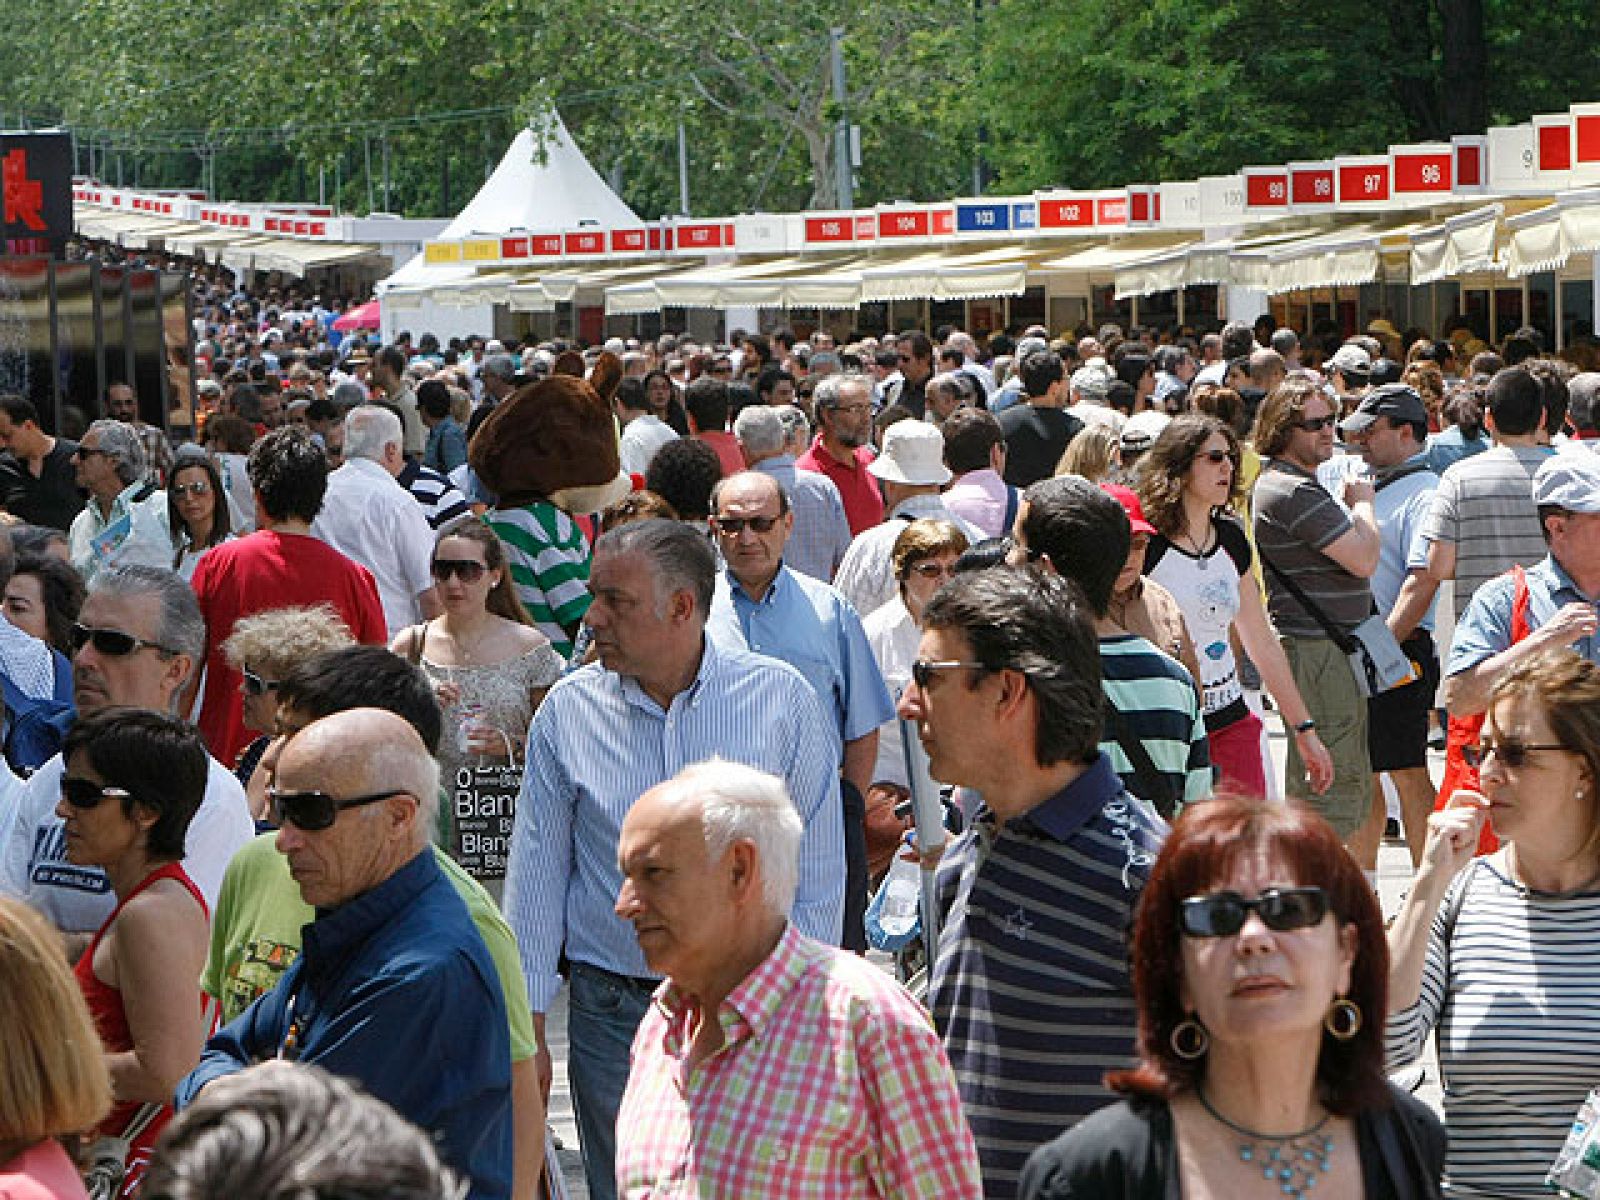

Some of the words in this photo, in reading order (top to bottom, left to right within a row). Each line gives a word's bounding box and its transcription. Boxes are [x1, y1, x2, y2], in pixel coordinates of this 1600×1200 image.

[1421, 164, 1441, 184] 96
[1269, 182, 1284, 198] 99
[1314, 179, 1330, 196] 98
[1364, 174, 1380, 193] 97
[974, 209, 995, 226] 103
[1059, 205, 1080, 221] 102
[897, 216, 916, 231] 104
[462, 833, 508, 854] Blan
